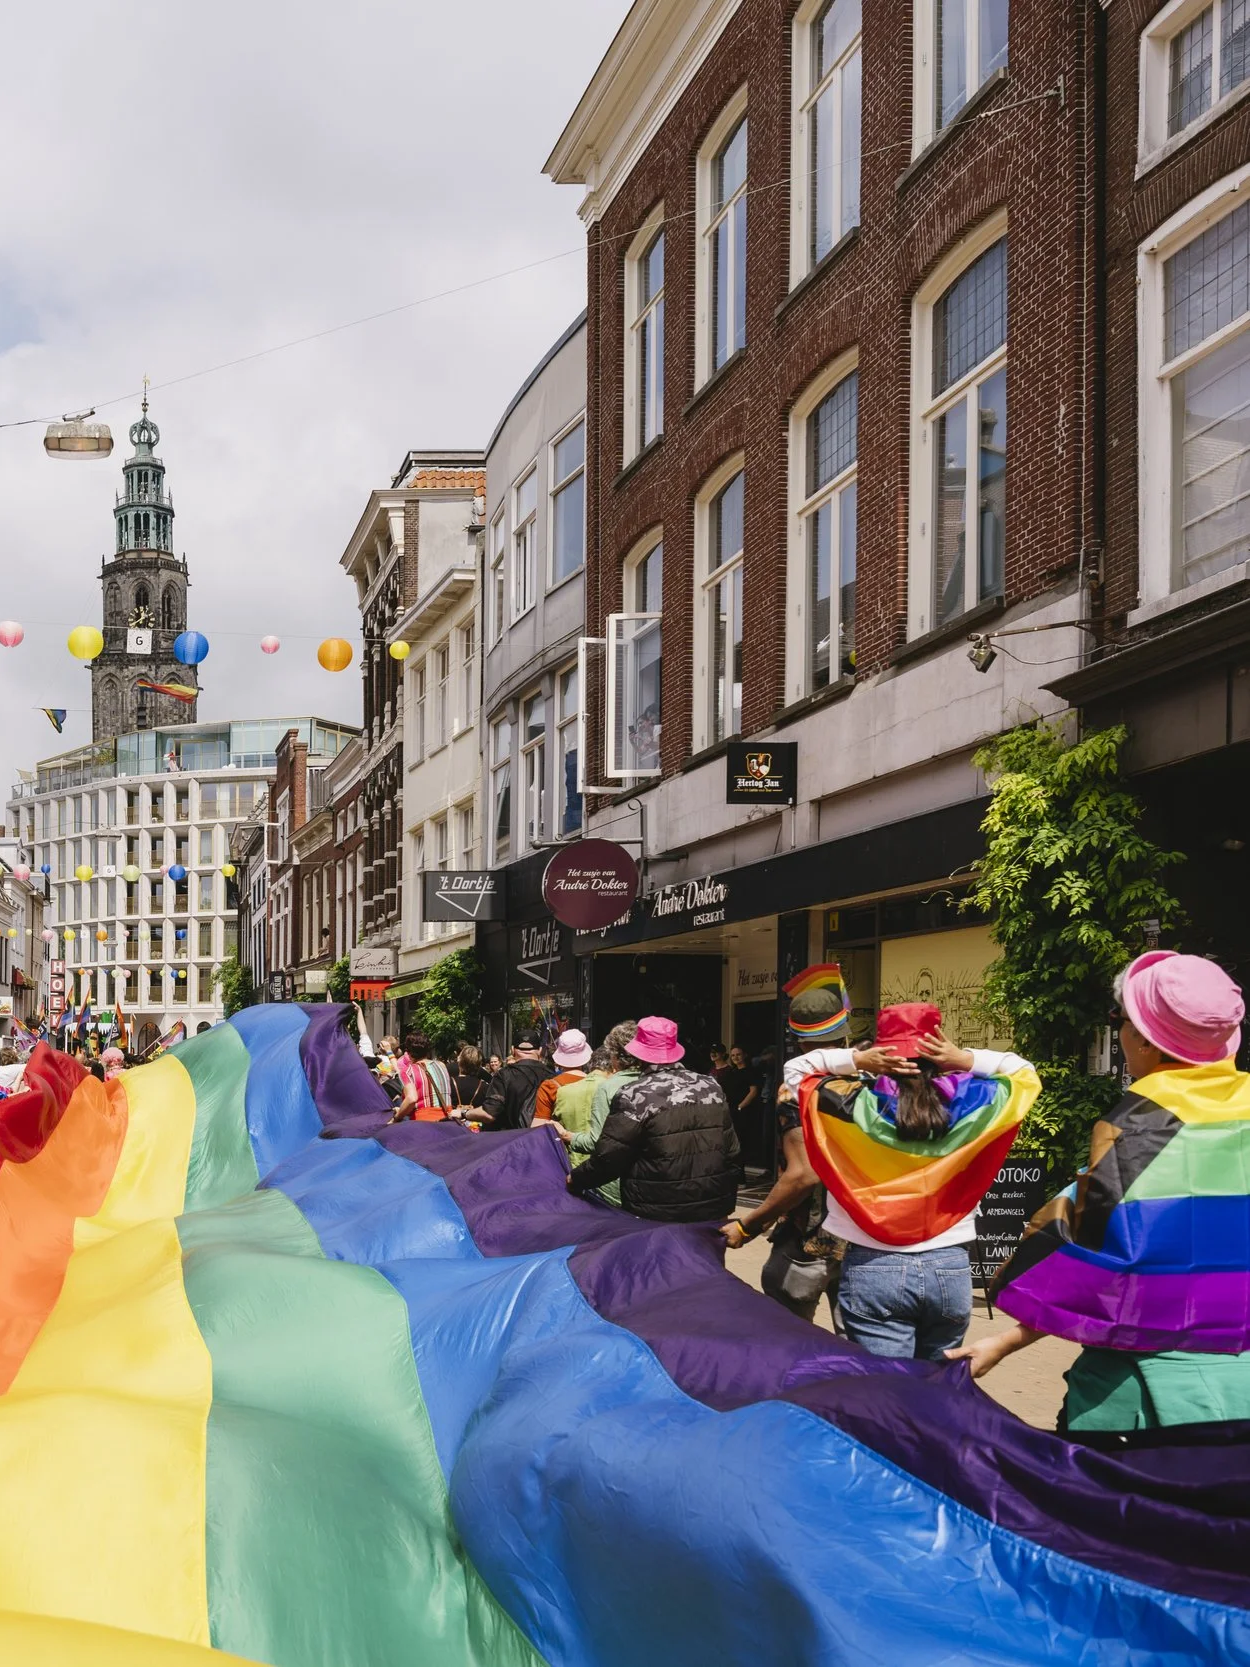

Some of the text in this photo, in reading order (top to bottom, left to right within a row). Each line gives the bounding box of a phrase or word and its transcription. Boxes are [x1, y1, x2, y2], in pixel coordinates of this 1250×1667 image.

[736, 778, 780, 790] Hertog Jan
[567, 868, 581, 877] Het
[582, 869, 601, 878] zusje
[553, 877, 629, 890] André Dokter
[651, 875, 728, 918] André Dokter
[693, 908, 726, 927] restaurant
[994, 1167, 1041, 1184] OTOKO
[986, 1207, 1026, 1217] ARMEDANGELS
